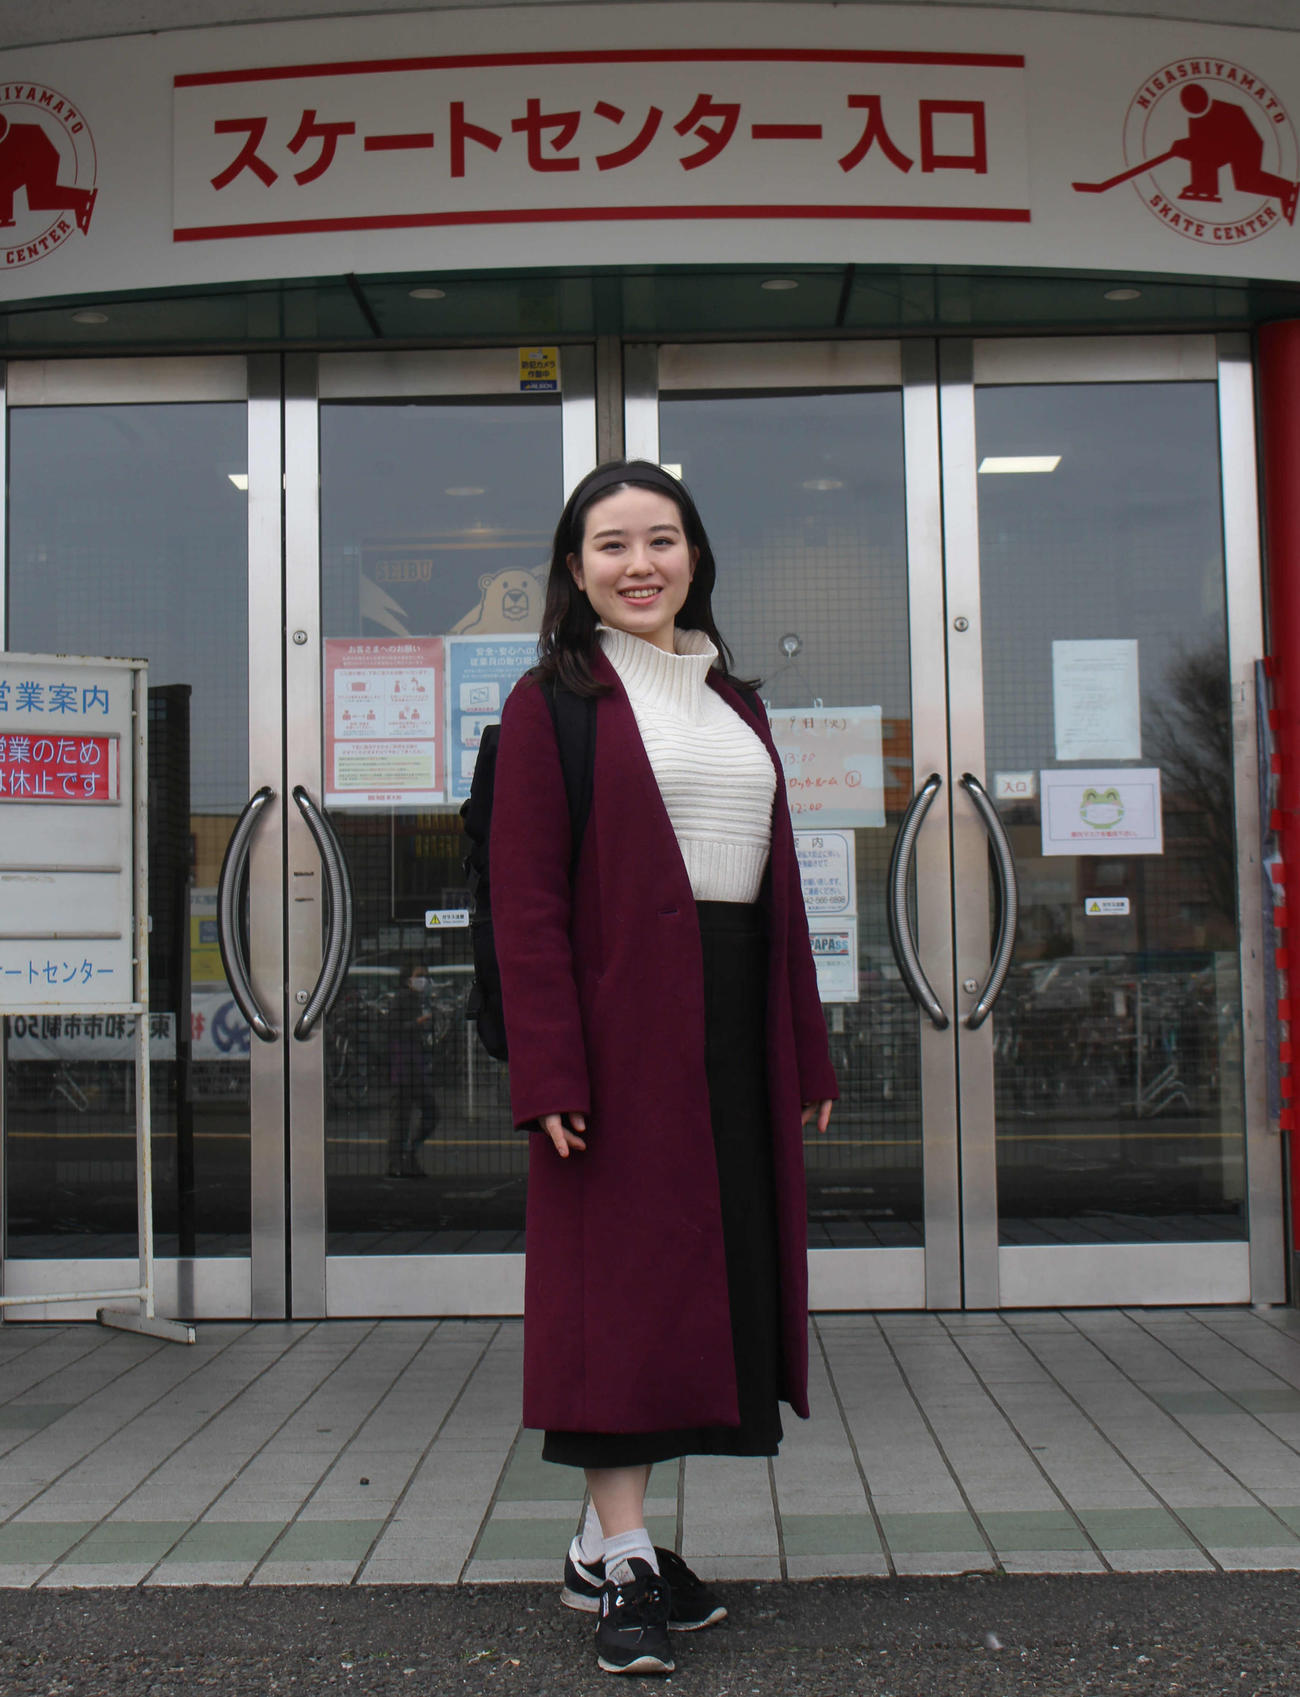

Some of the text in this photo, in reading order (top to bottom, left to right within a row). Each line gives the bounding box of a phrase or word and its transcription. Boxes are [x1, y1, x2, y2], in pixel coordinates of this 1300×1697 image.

[0, 86, 85, 135] IYAMATO
[1136, 61, 1286, 125] HIGASHIYAMATO
[210, 93, 988, 192] スケートセンター入口
[1149, 194, 1278, 241] SKATE CENTER
[6, 219, 72, 265] CENTER
[0, 735, 101, 765] 業のため
[1003, 781, 1027, 793] 入口
[0, 959, 114, 985] ートセンター
